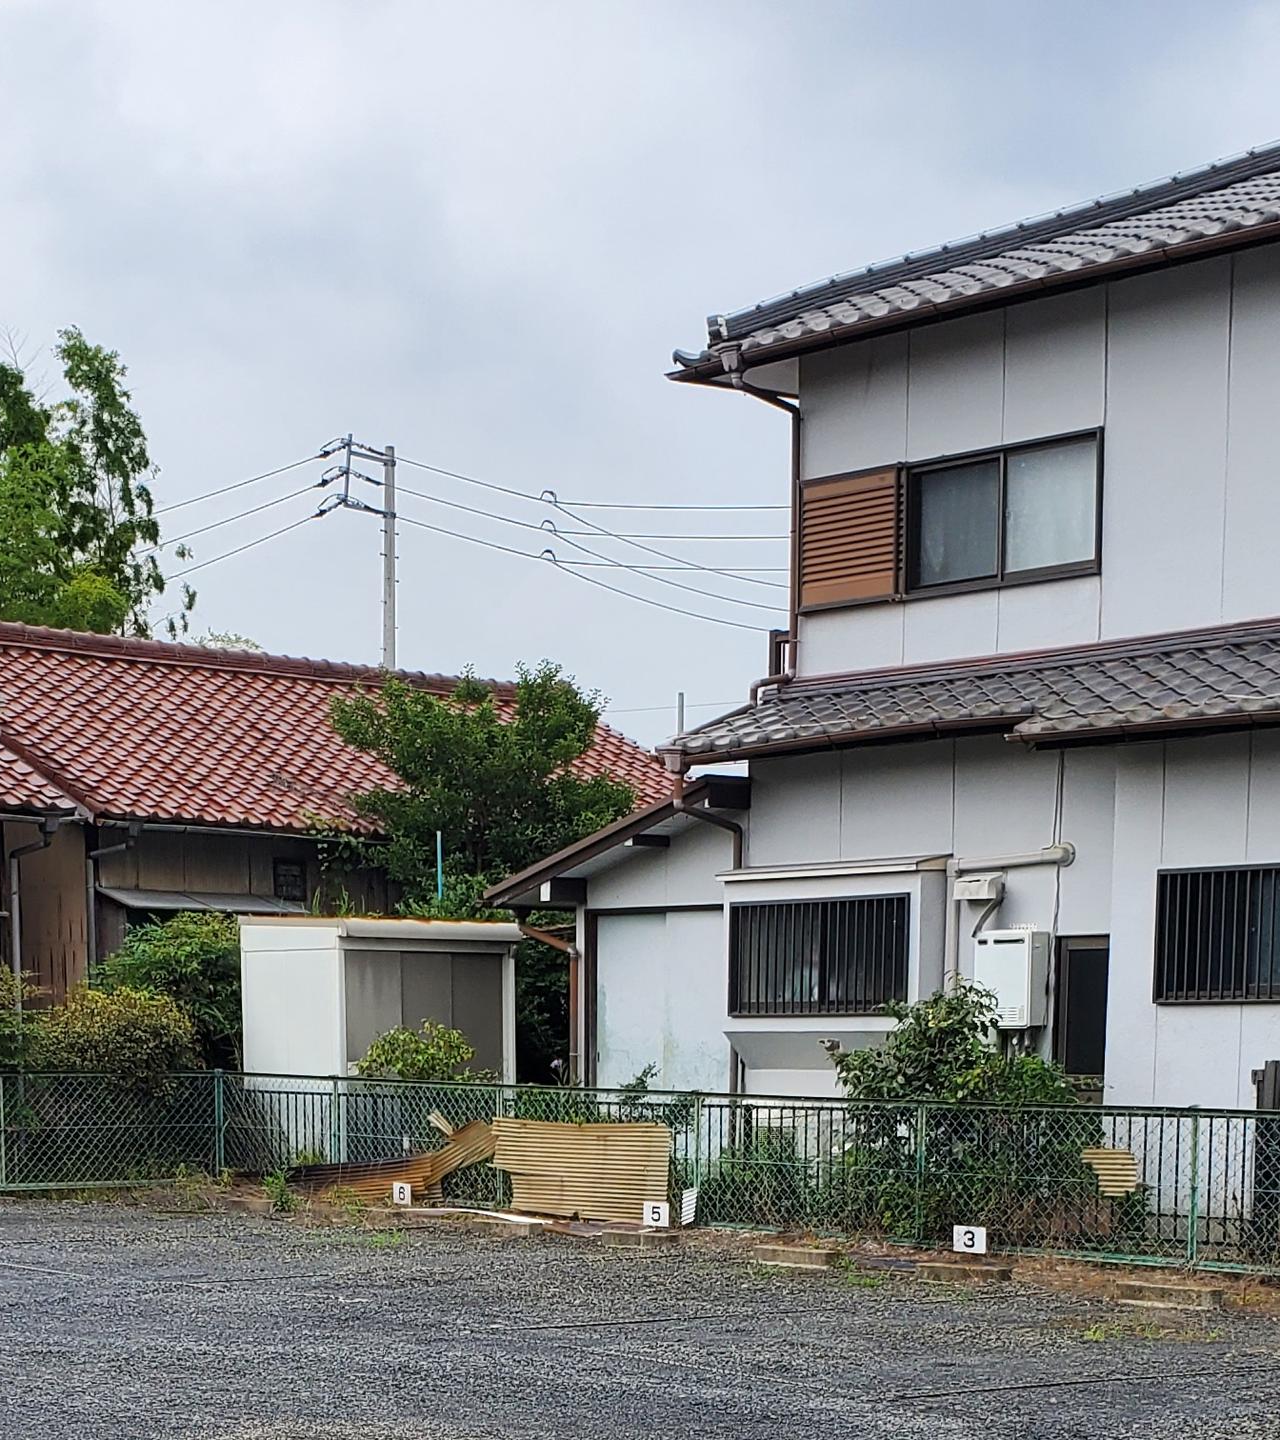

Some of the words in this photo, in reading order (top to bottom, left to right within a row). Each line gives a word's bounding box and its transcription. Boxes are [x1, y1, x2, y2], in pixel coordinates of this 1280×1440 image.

[398, 1186, 406, 1201] 6
[651, 1206, 661, 1222] 5
[963, 1230, 975, 1248] 3
